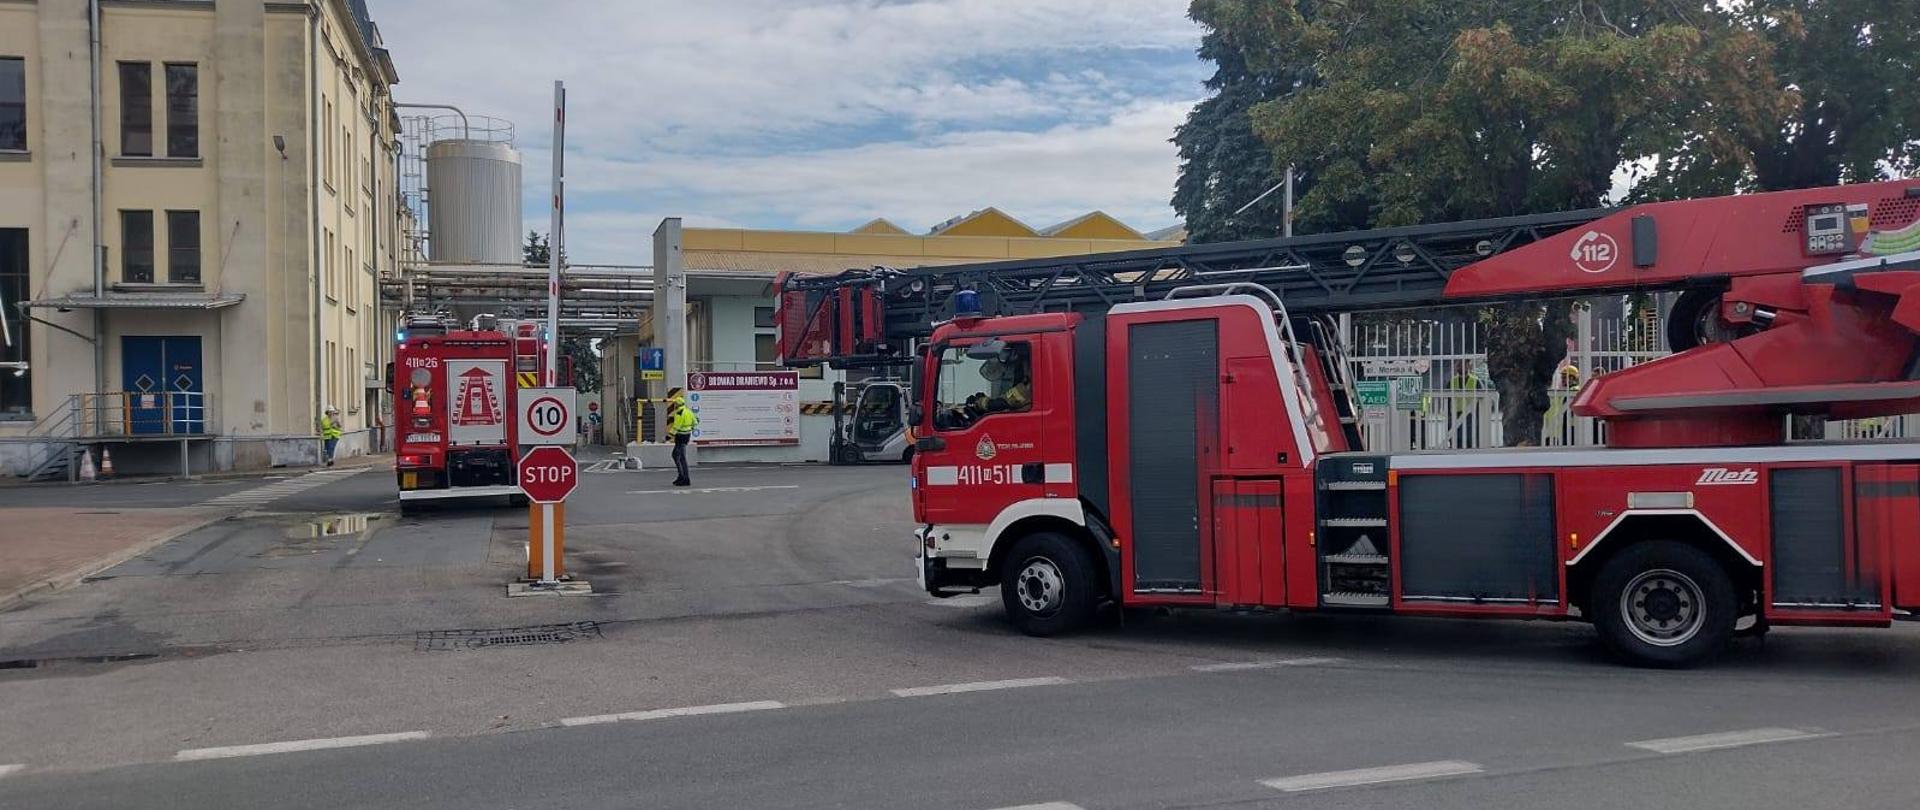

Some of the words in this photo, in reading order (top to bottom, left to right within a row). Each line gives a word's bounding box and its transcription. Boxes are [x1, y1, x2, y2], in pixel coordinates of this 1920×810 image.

[1583, 244, 1610, 261] 112
[535, 406, 561, 426] 10
[525, 466, 572, 483] STOP
